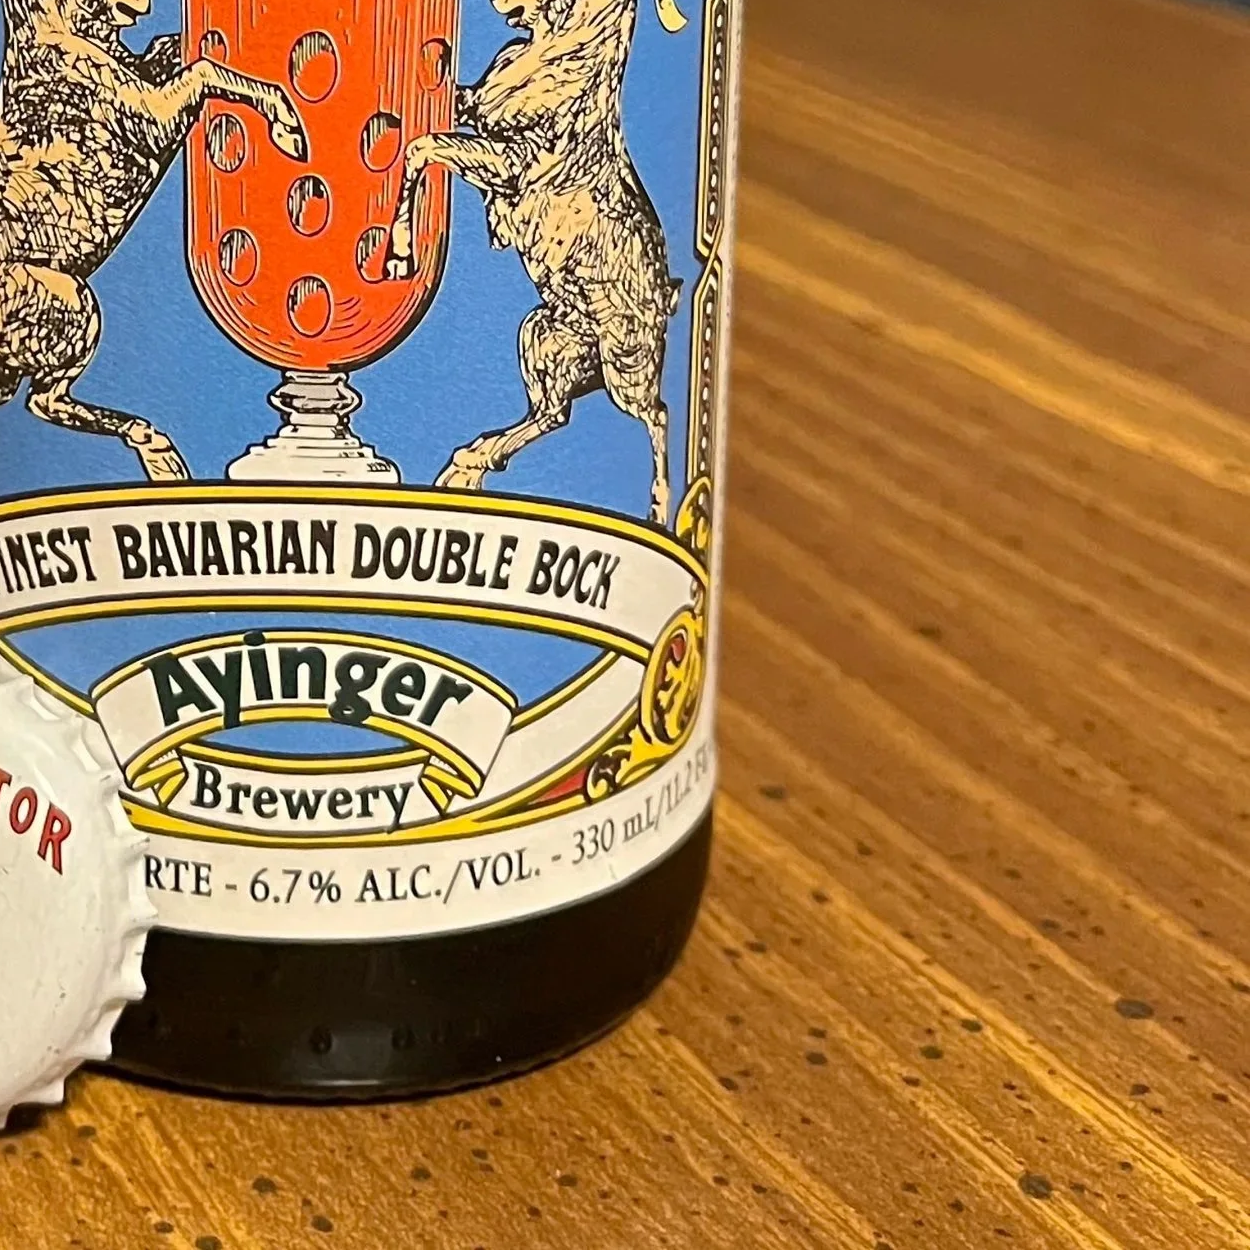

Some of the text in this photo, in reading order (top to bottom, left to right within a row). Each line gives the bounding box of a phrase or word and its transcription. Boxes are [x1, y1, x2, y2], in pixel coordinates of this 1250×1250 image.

[112, 519, 337, 580] BAVARIAN
[350, 523, 518, 590] DOUBLE
[526, 539, 621, 610] BOCK
[147, 630, 472, 729] Ayinger
[190, 761, 415, 834] Brewery
[144, 854, 212, 897] RTE
[249, 867, 342, 904] 6.7%
[354, 845, 541, 904] ALC./VOL.
[571, 821, 616, 865] 330
